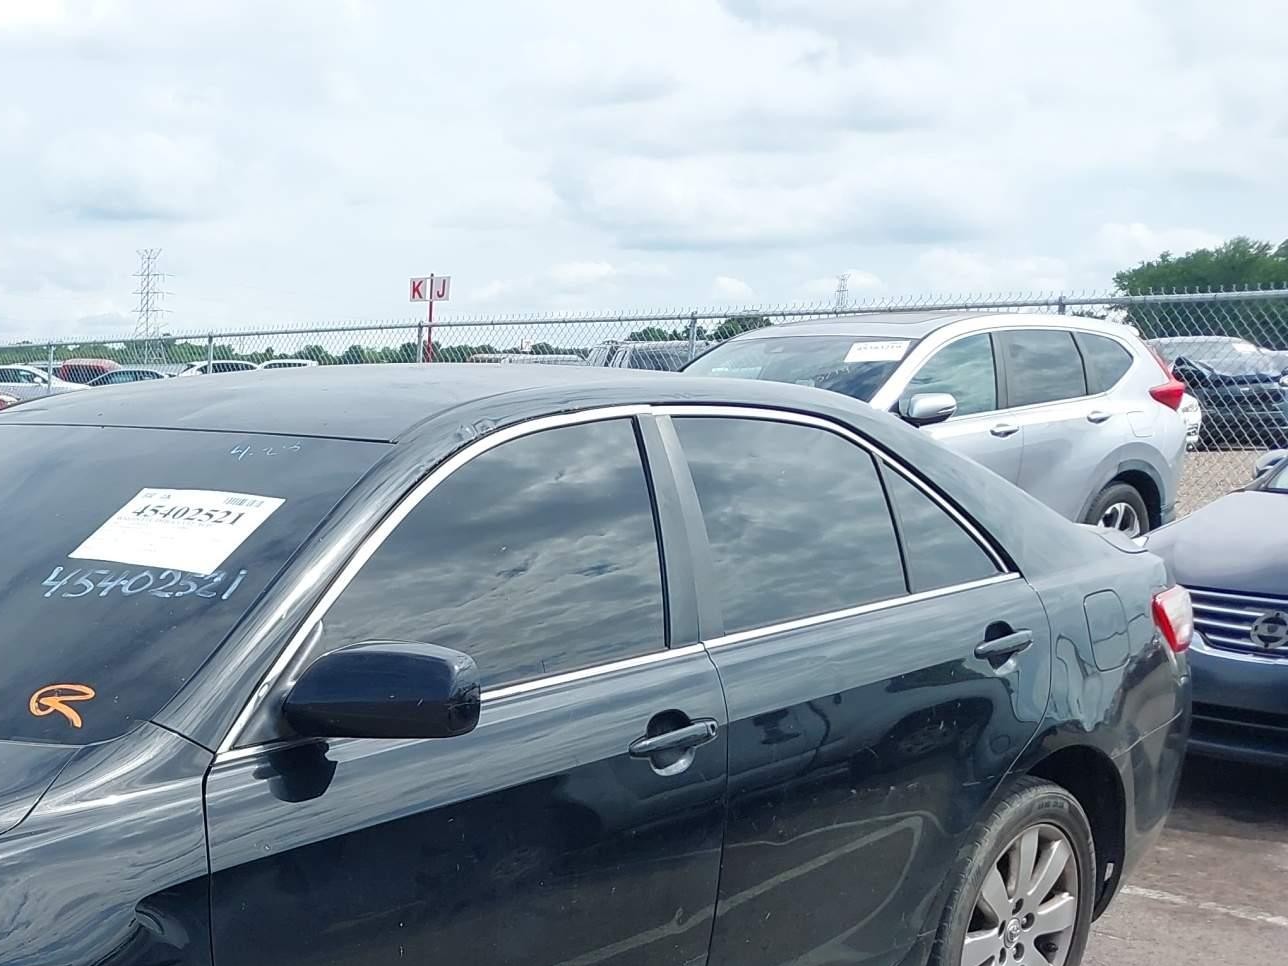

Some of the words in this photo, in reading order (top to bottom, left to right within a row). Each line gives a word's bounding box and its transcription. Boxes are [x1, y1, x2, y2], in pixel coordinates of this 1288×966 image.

[411, 280, 423, 299] K
[436, 279, 447, 298] J
[132, 504, 247, 526] 45402521
[41, 566, 248, 600] 45402521
